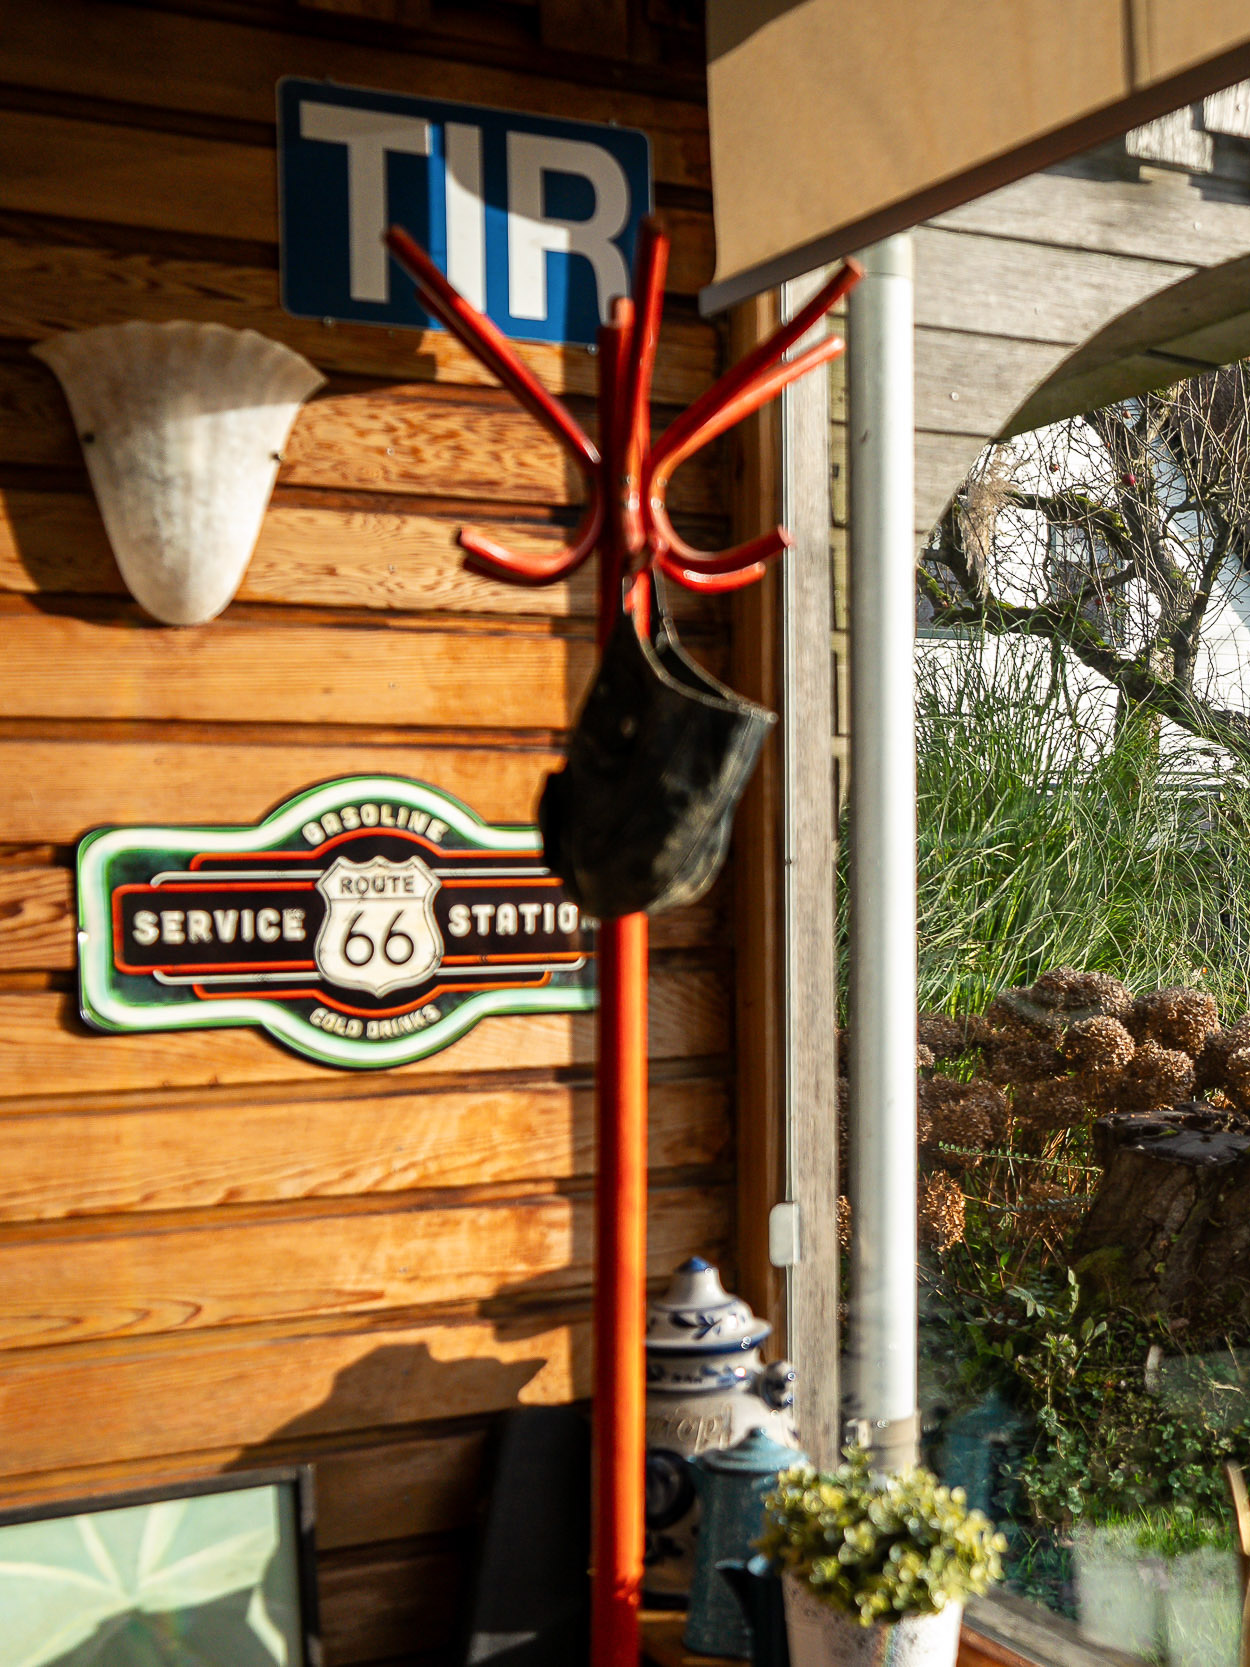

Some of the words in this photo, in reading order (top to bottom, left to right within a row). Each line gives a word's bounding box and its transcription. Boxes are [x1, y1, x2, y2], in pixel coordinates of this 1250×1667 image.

[299, 100, 632, 326] TIR
[301, 803, 450, 846] GASOLINE
[340, 875, 415, 895] ROUTE
[132, 907, 307, 946] SERVICE
[339, 909, 415, 967] 66
[448, 901, 600, 937] STATIO
[309, 1007, 364, 1039] COLD
[366, 1004, 442, 1040] DRINKS
